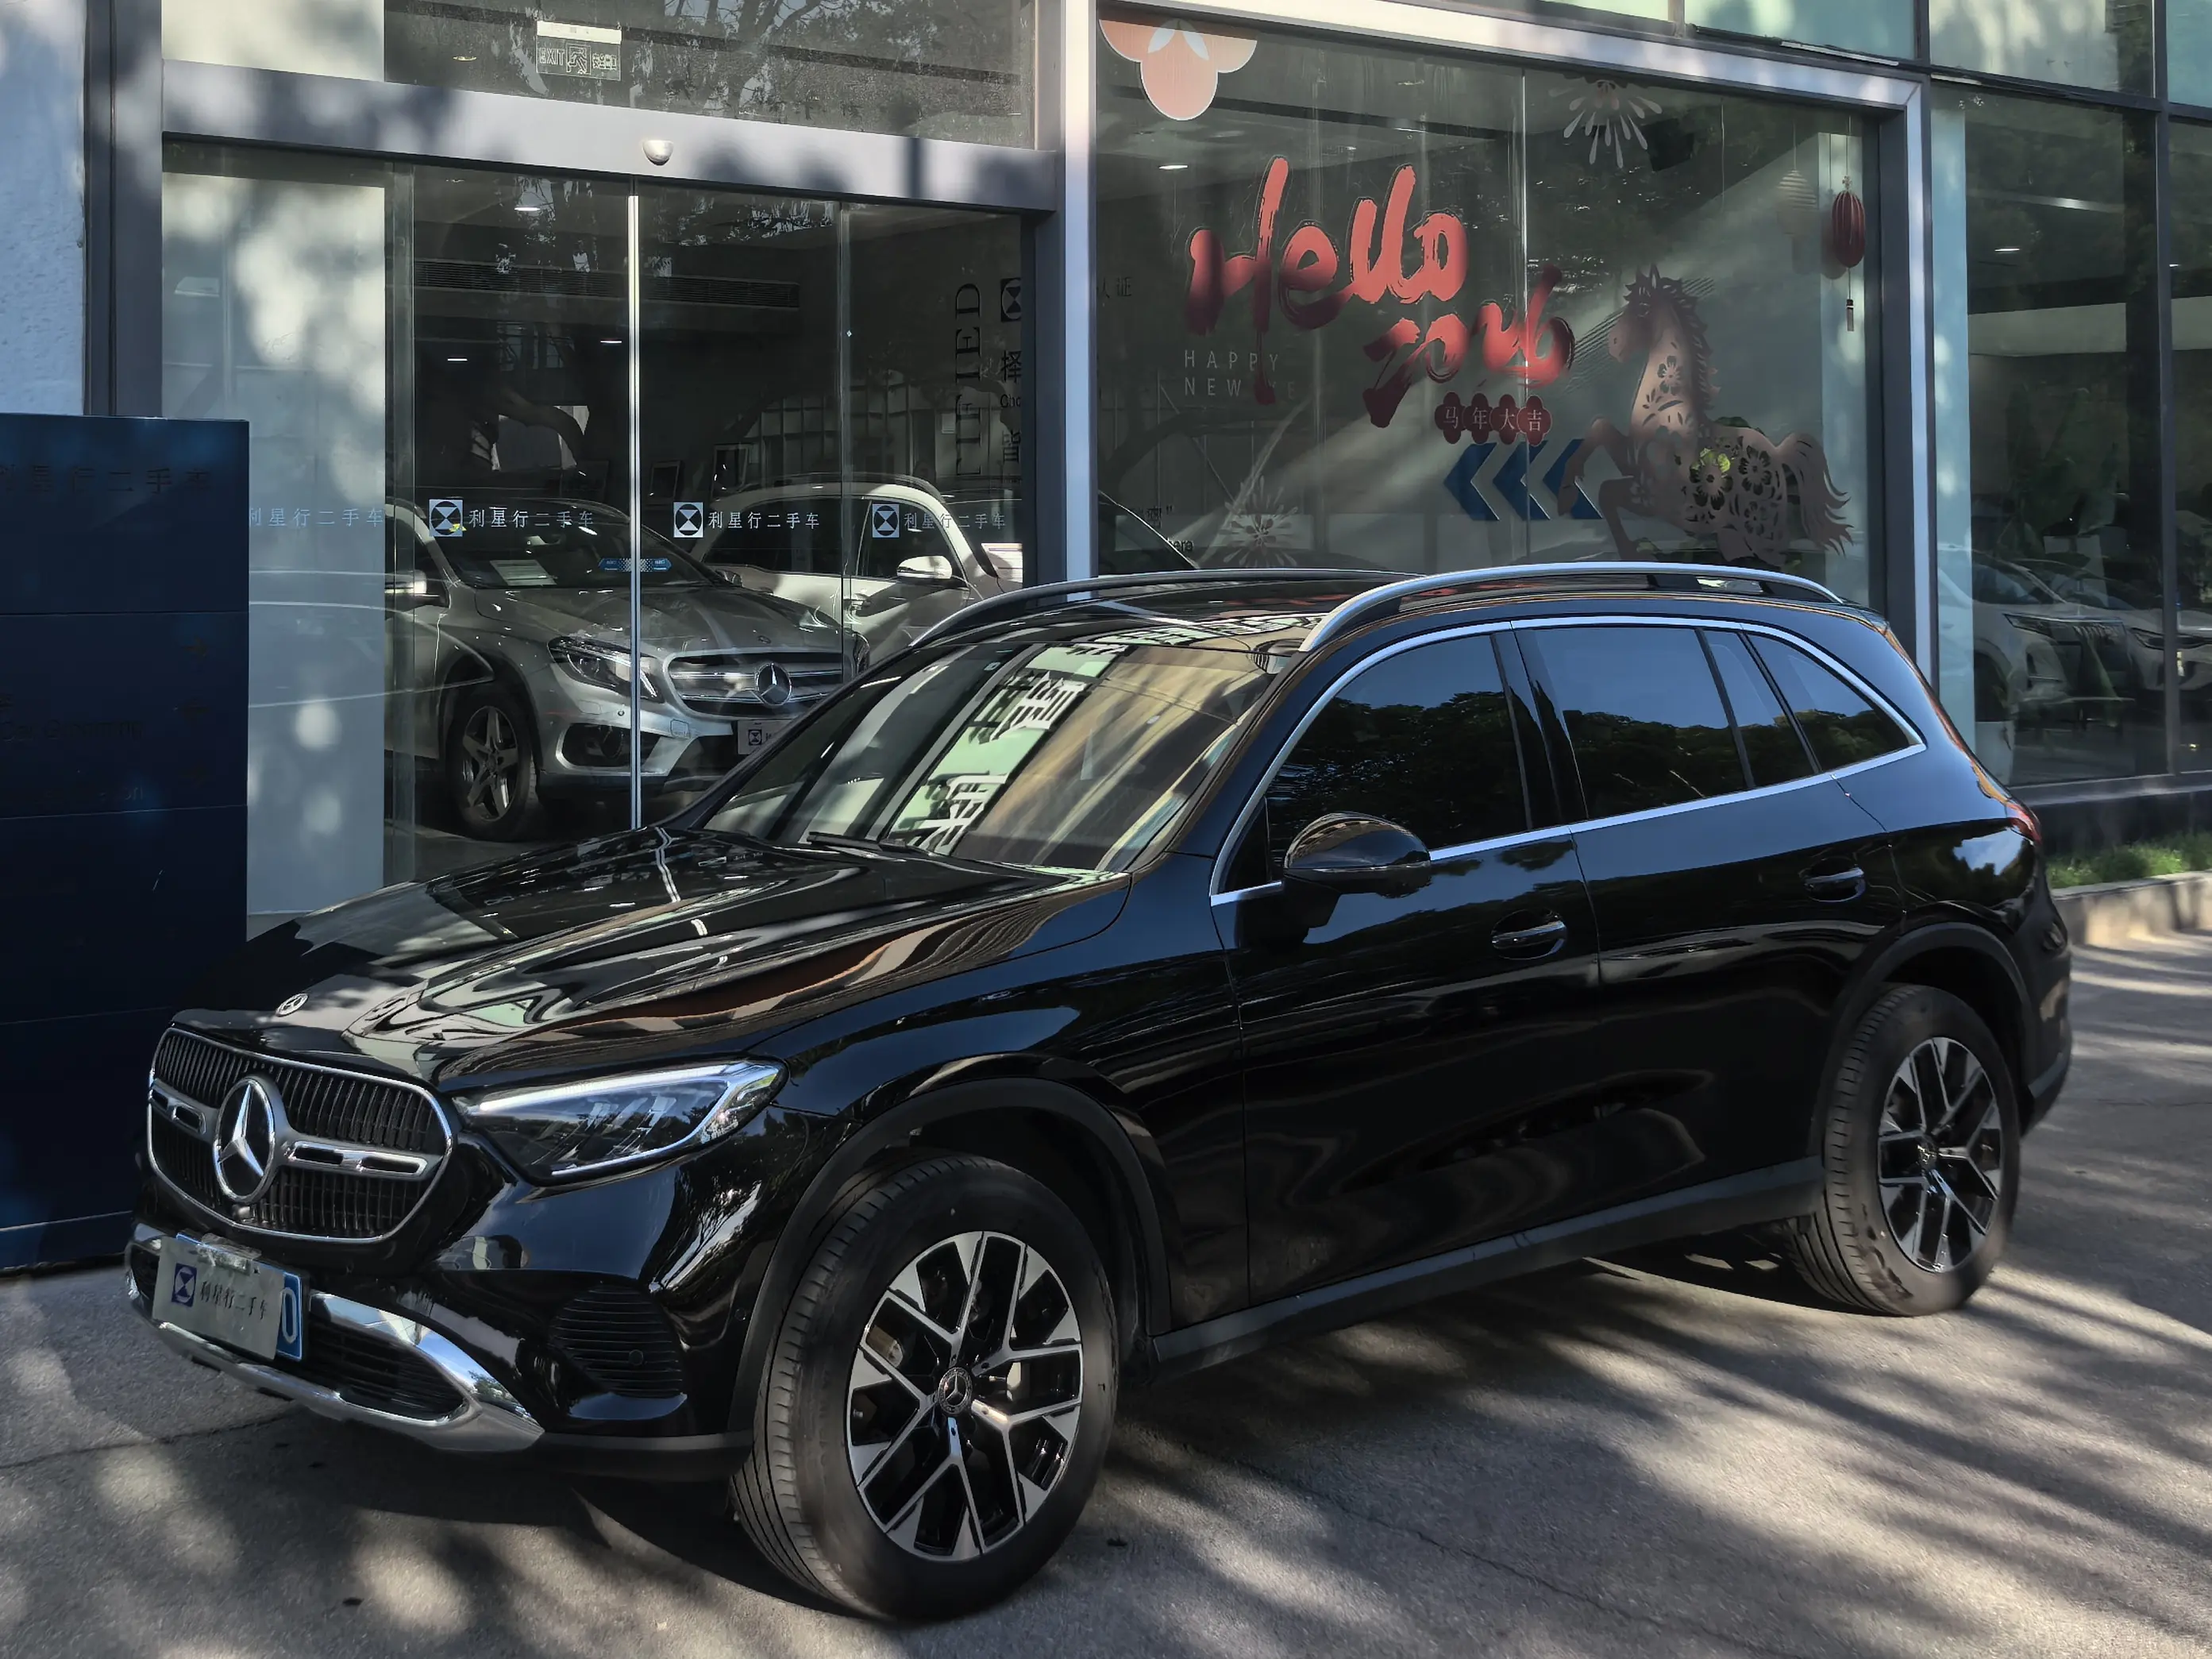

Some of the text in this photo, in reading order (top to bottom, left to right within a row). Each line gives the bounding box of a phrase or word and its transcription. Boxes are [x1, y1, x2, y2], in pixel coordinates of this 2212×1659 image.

[540, 47, 565, 66] EXIT
[1186, 155, 1468, 404] Hello
[1185, 349, 1278, 372] HAPPY
[1185, 377, 1242, 397] NEW
[1443, 406, 1542, 432] 马年大吉
[249, 507, 384, 527] 利星行二手车
[468, 507, 594, 528] 利星行二手车
[708, 511, 819, 530] 利星行二手车
[904, 511, 1005, 530] 利星行二手车
